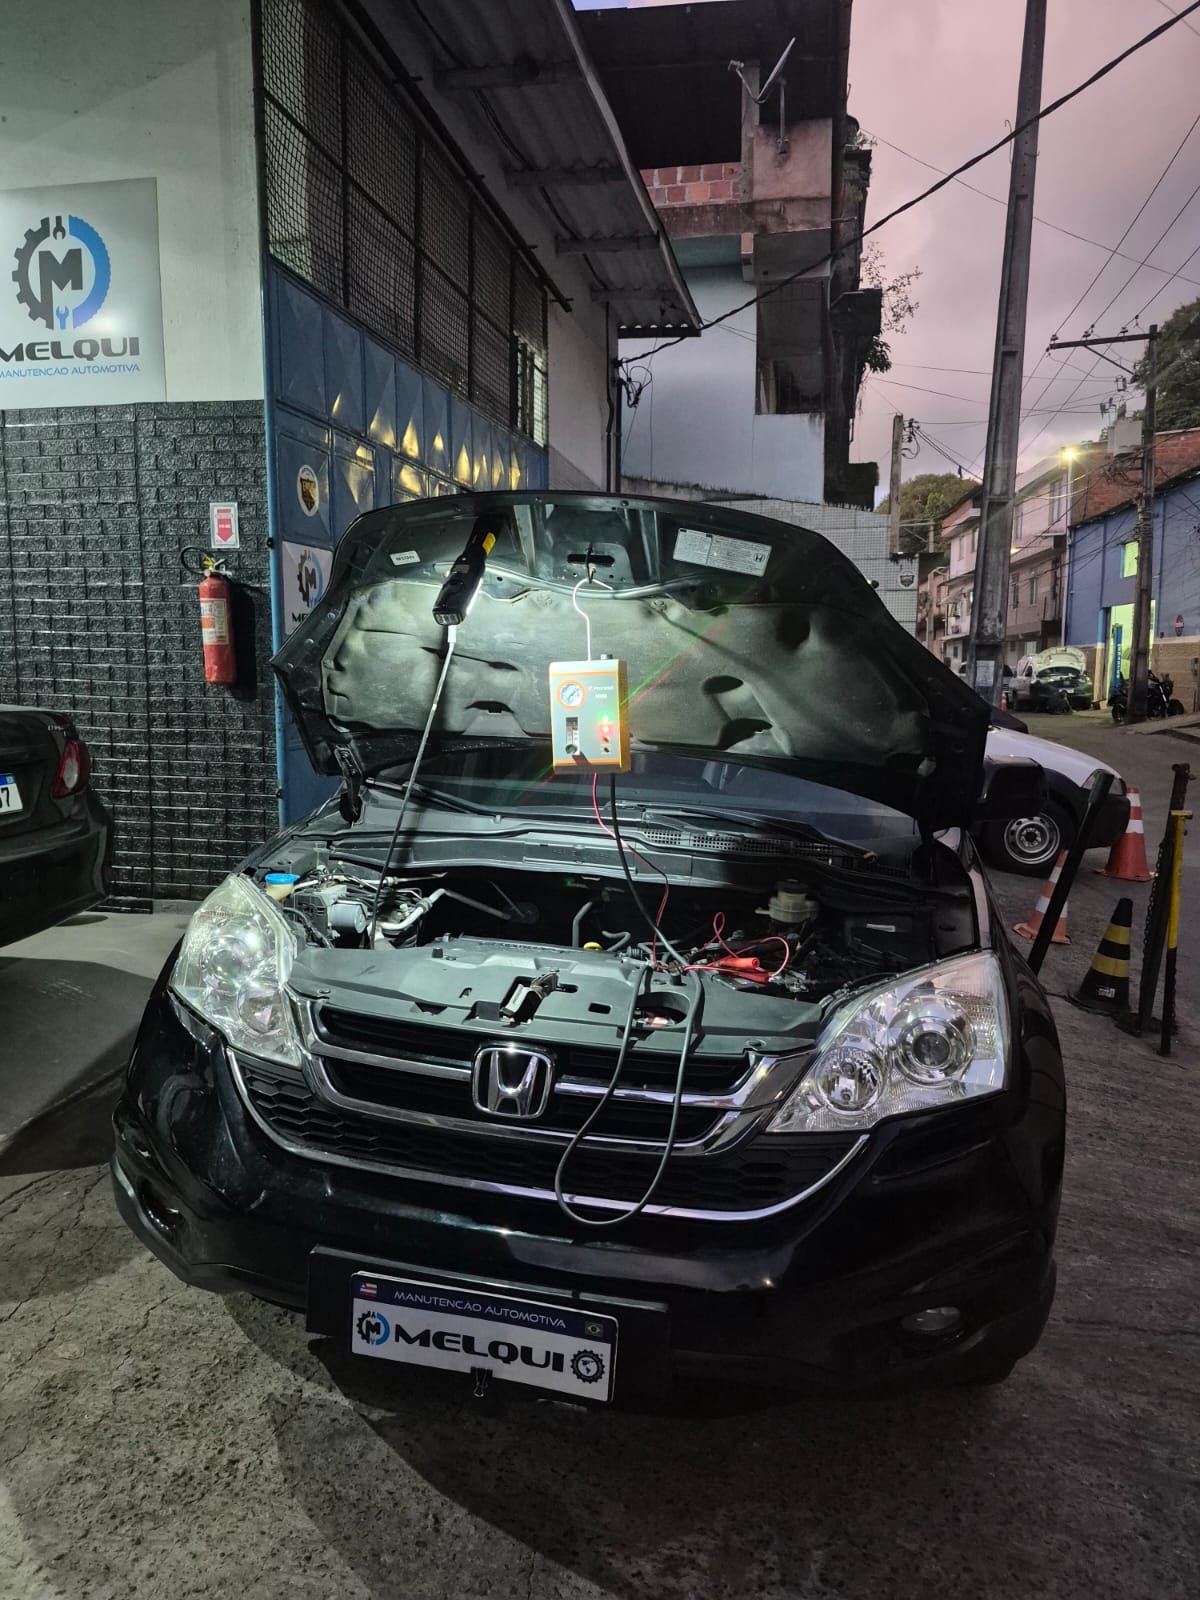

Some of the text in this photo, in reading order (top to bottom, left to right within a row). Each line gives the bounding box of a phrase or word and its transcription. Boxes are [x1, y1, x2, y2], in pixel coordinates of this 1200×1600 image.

[0, 336, 140, 362] MELQUI
[71, 364, 141, 376] AUTOMOTIVA
[0, 786, 11, 809] 7
[485, 1306, 567, 1329] AUTOMOTIVA
[394, 1323, 565, 1373] MELQUI
